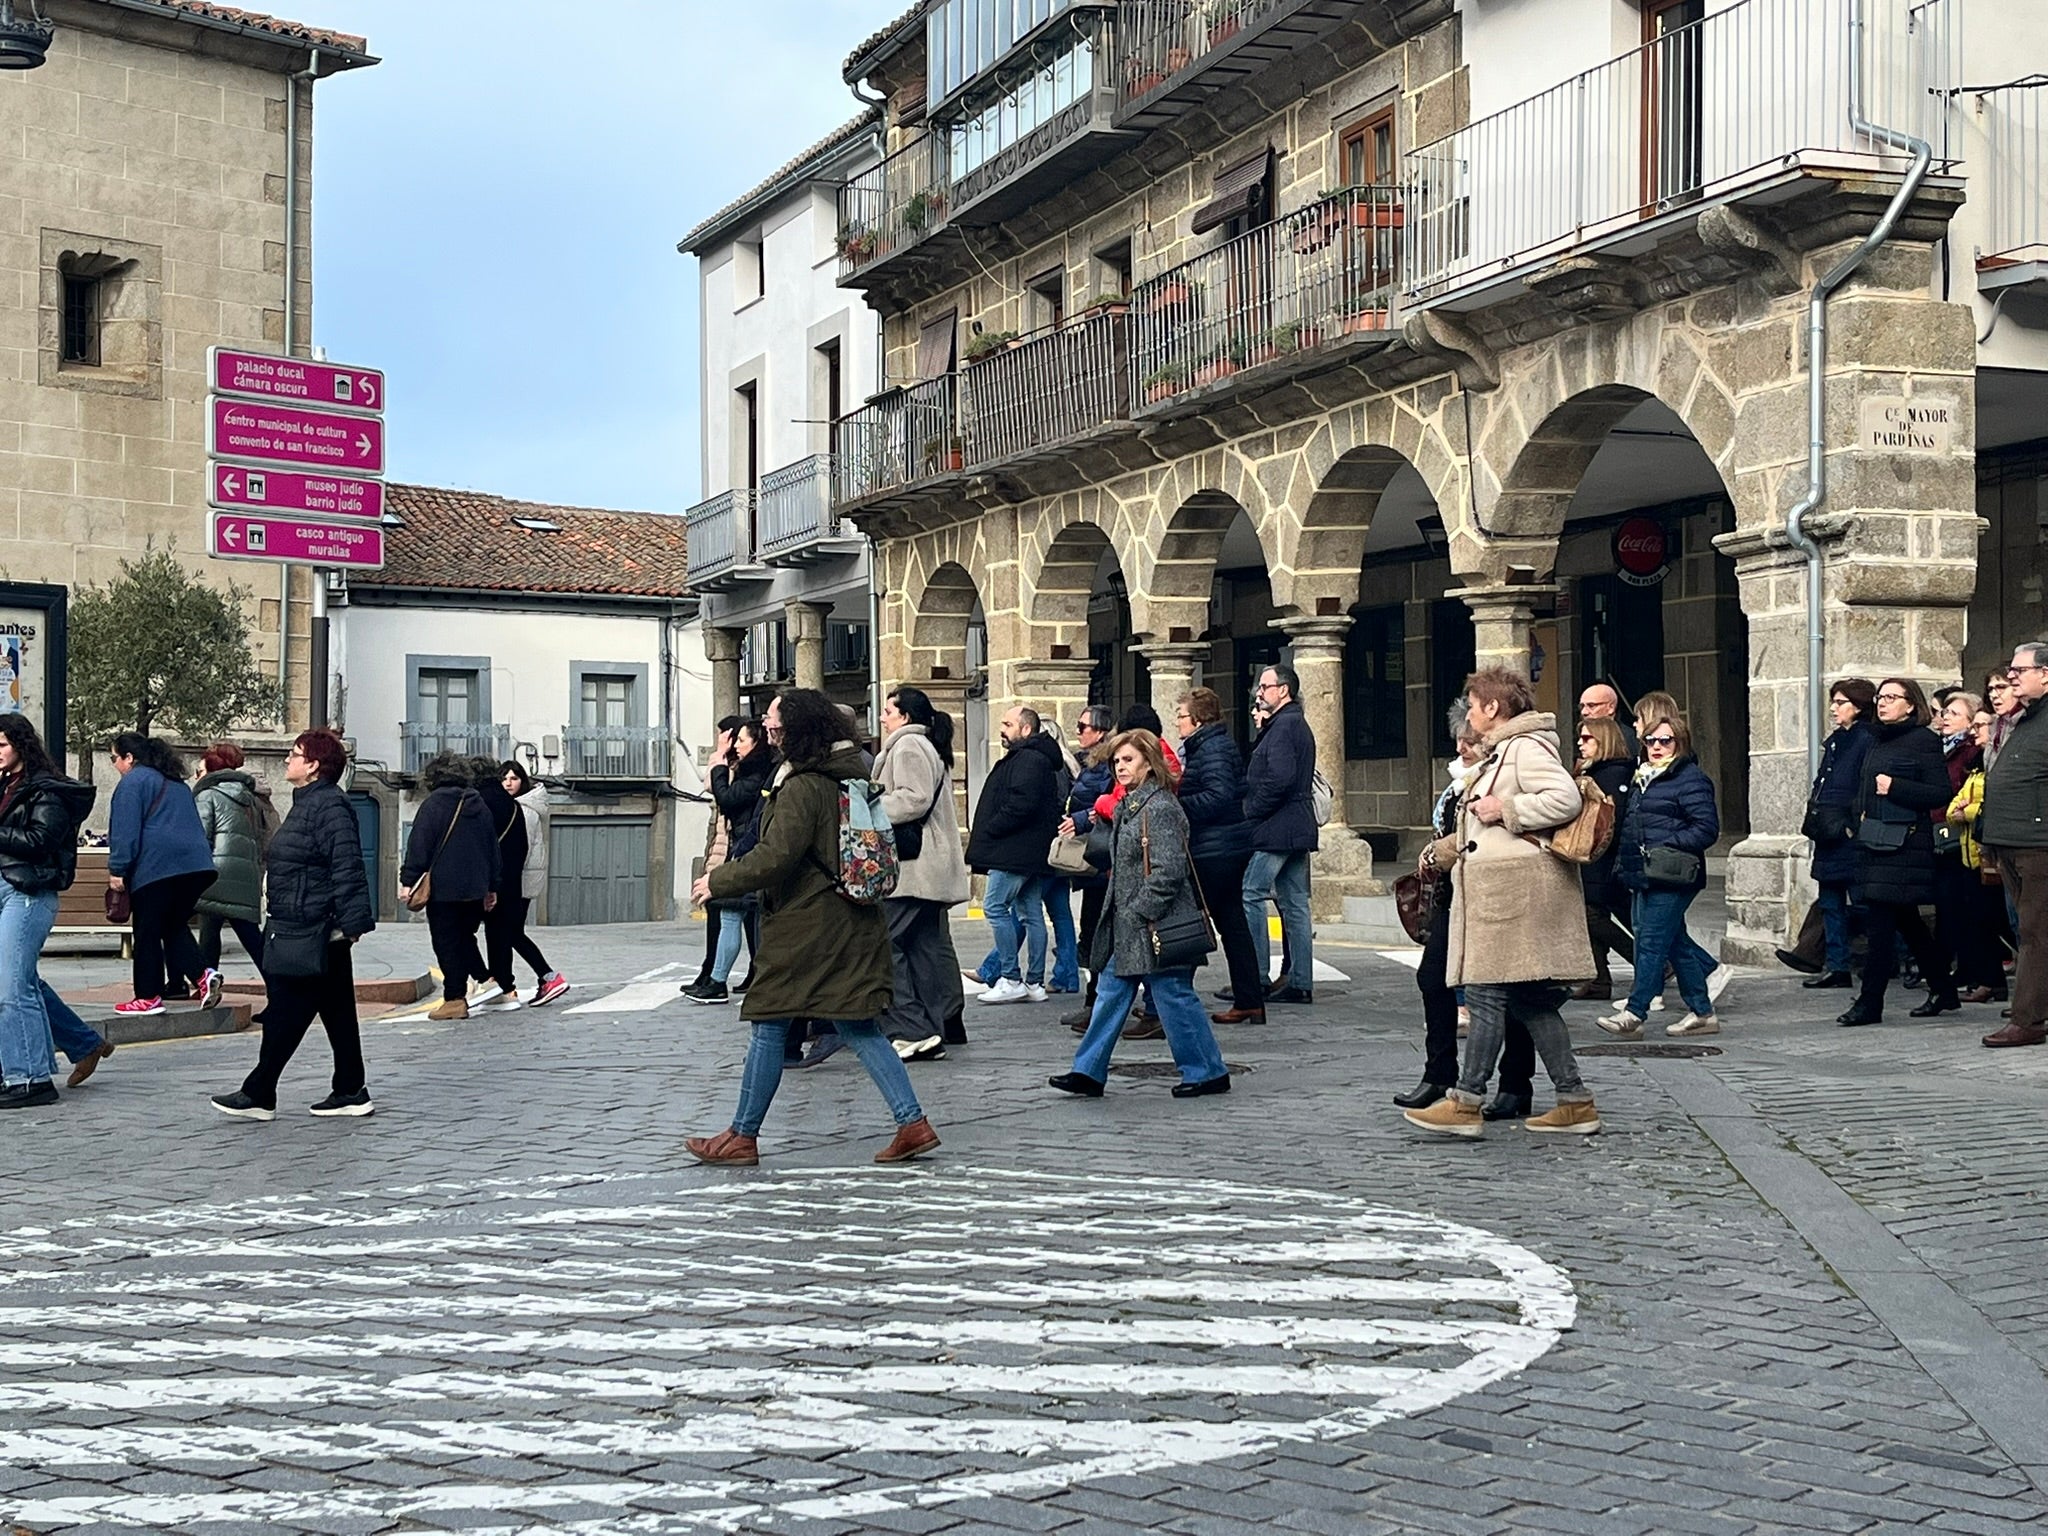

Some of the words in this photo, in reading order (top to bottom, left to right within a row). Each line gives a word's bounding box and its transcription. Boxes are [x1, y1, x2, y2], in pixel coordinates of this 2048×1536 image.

[236, 360, 274, 375] palacio
[277, 365, 305, 380] ducal
[233, 374, 271, 391] cámara
[274, 382, 308, 395] oscura
[1908, 408, 1948, 422] MAYOR
[226, 415, 256, 428] centro
[257, 419, 301, 434] municipal
[302, 423, 315, 436] de
[316, 426, 347, 439] cultura
[1899, 421, 1914, 433] DE
[229, 435, 271, 449] convento
[273, 439, 285, 450] de
[286, 442, 303, 452] san
[305, 442, 344, 457] francisco
[305, 480, 337, 493] museo
[340, 481, 364, 496] judío
[305, 494, 335, 509] barrio
[338, 498, 362, 512] judío
[296, 528, 324, 540] casco
[328, 529, 364, 545] antiguo
[308, 544, 350, 558] murallas
